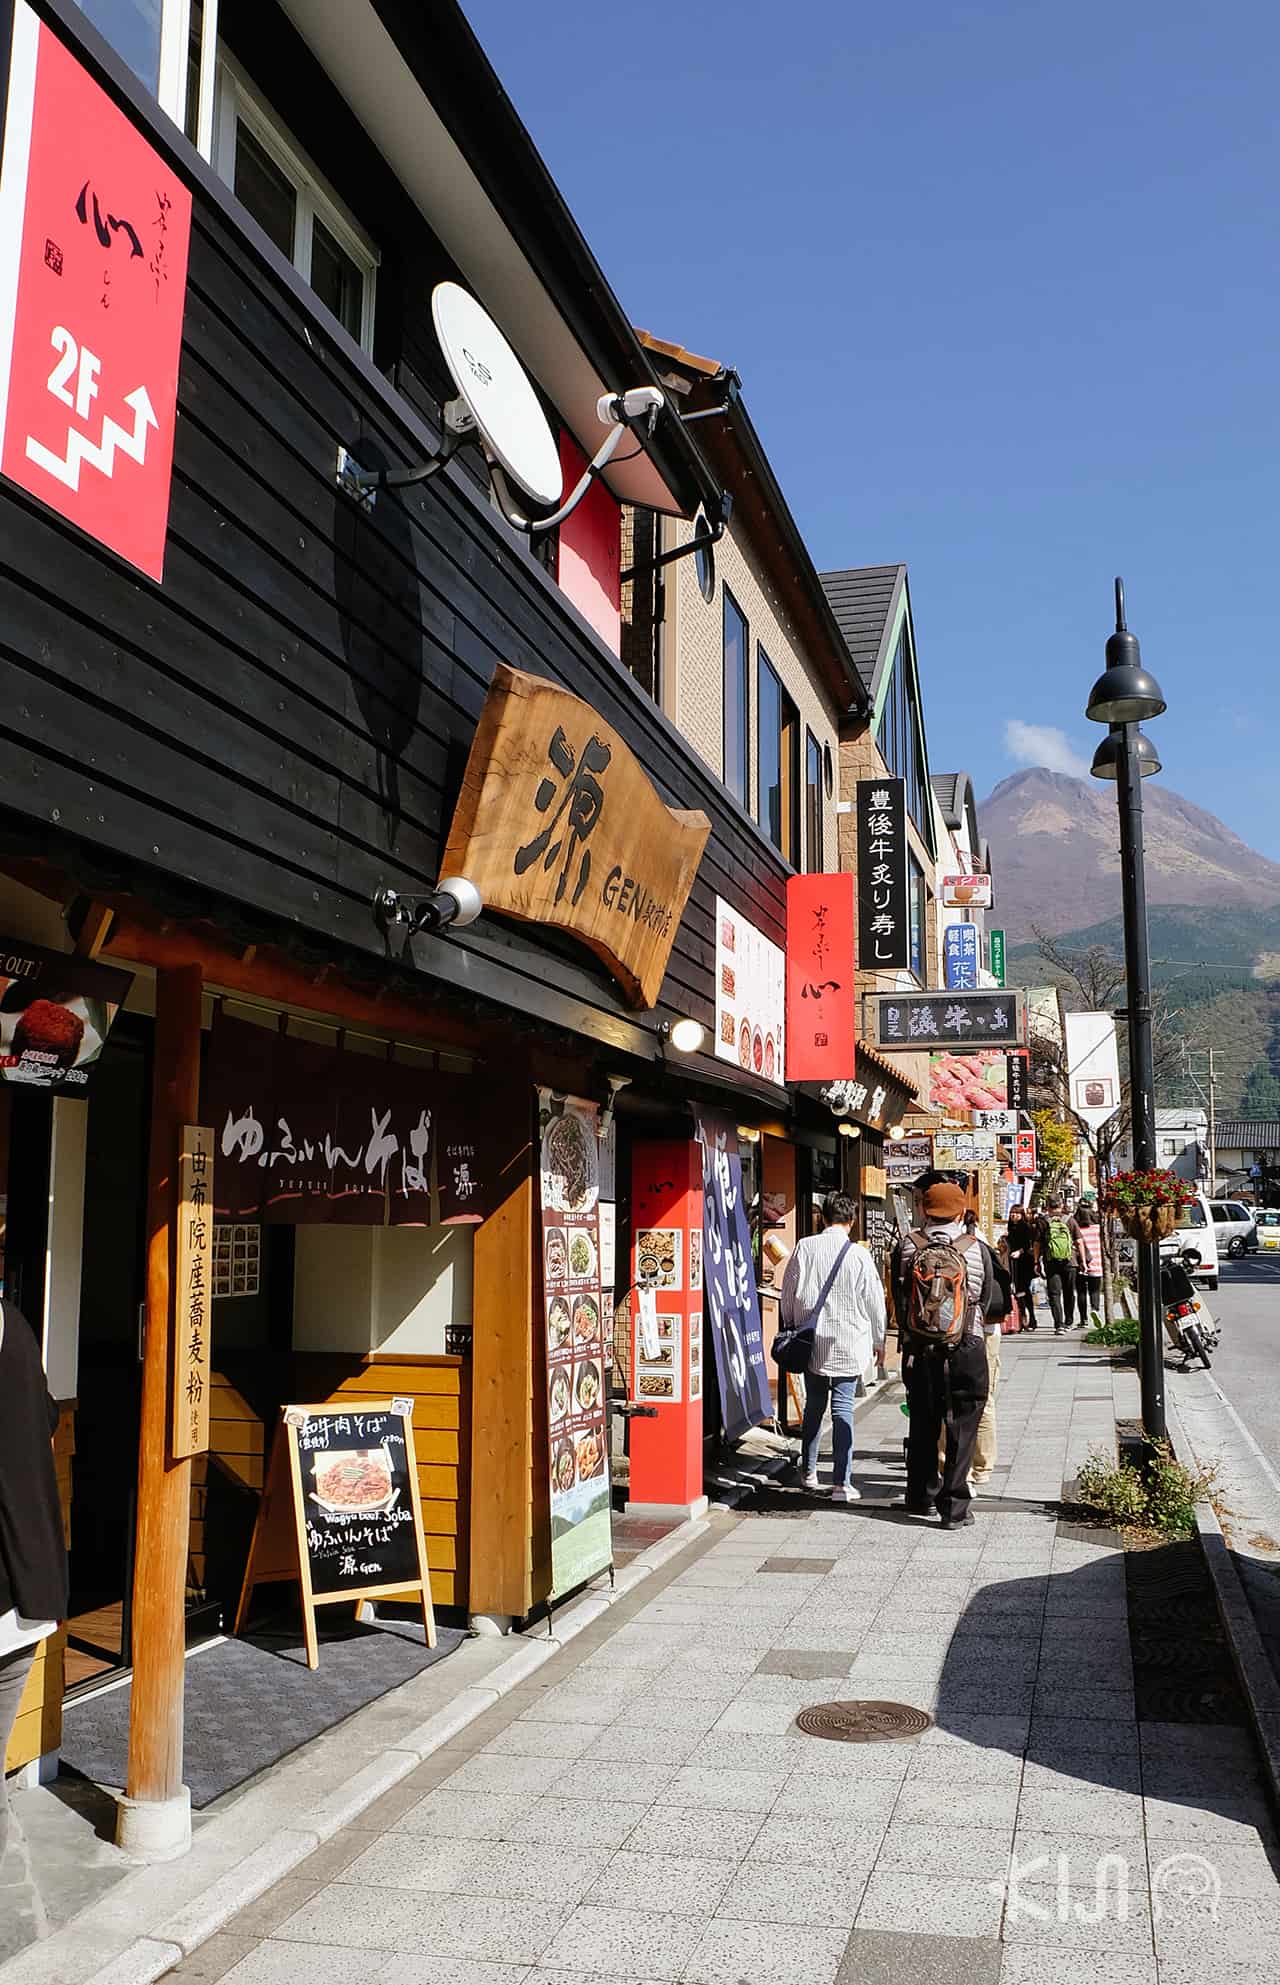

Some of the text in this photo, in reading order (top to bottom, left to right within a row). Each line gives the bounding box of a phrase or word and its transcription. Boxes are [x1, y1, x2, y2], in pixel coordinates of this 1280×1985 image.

[48, 325, 102, 422] 2F
[602, 864, 648, 922] GEN
[868, 788, 895, 961] 豊後牛炙り寿し
[5, 955, 37, 977] OUT
[952, 961, 973, 989] 花水
